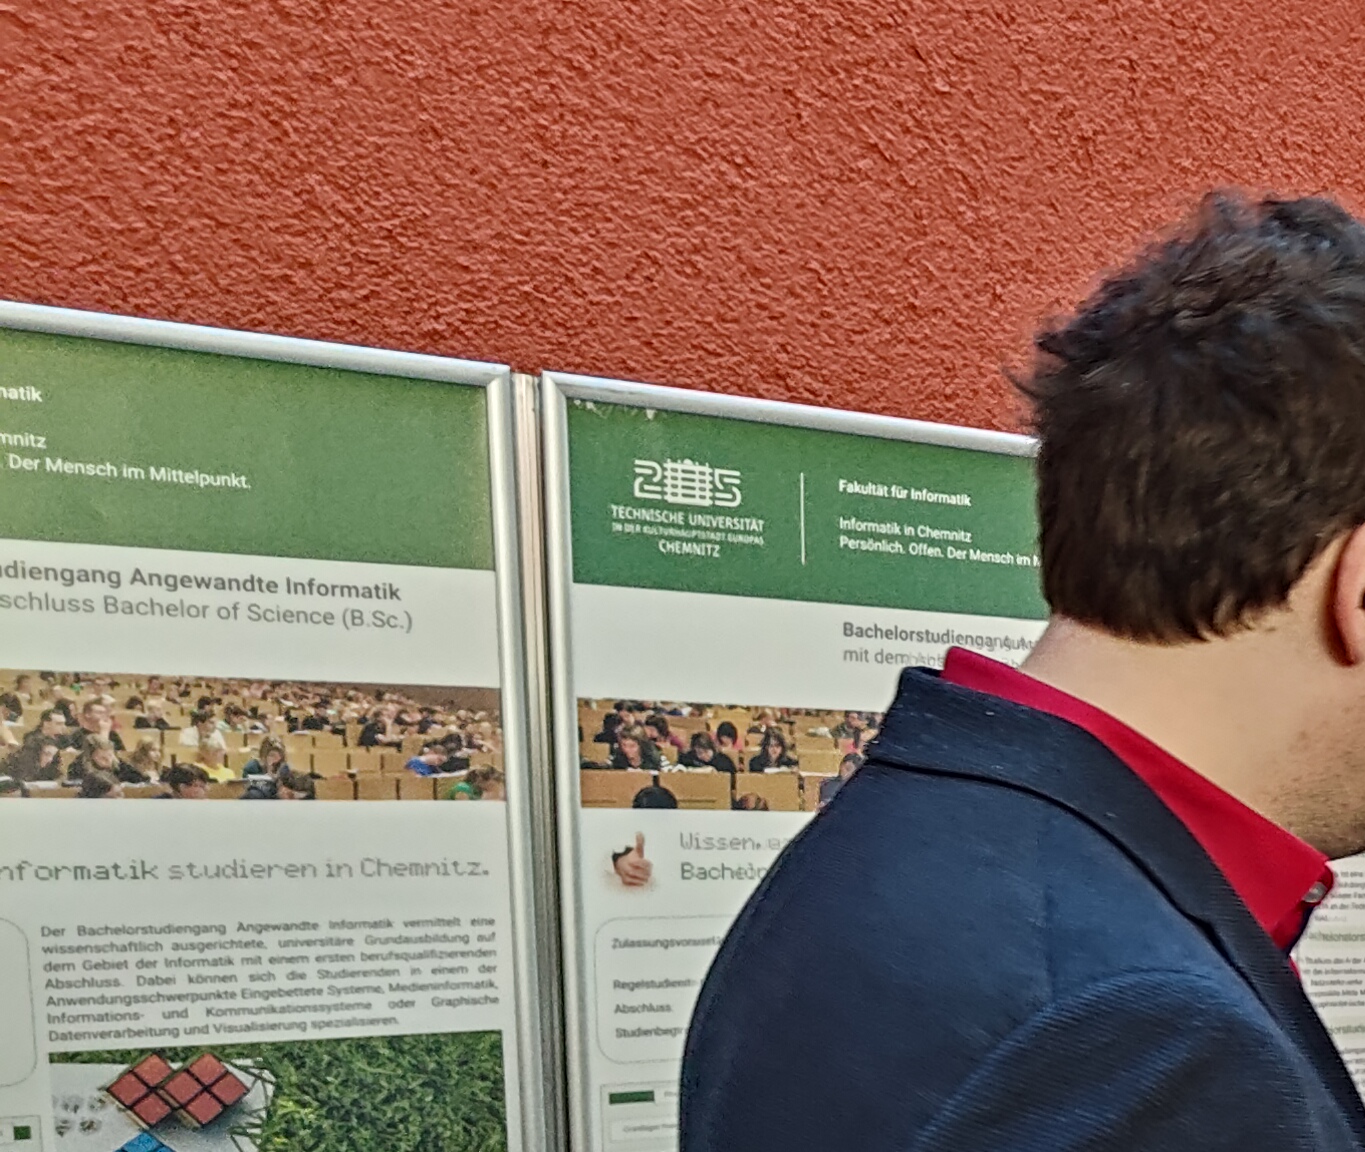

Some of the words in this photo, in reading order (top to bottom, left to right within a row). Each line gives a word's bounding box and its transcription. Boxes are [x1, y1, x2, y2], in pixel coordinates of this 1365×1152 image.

[9, 453, 39, 471] Der
[45, 457, 118, 477] Mensch
[122, 463, 145, 480] im
[150, 466, 252, 489] Mittelpunkt.
[838, 479, 888, 497] Fakultät
[891, 486, 908, 499] für
[911, 488, 972, 507] Informatik
[610, 504, 685, 525] TECHNISCHE
[688, 512, 765, 532] UNIVERSITÄT
[839, 517, 901, 535] Informatik
[904, 523, 915, 536] in
[918, 525, 972, 543] Chemnitz
[658, 539, 721, 558] CHEMNITZ
[908, 543, 944, 558] Offen.
[947, 546, 967, 560] Der
[969, 549, 1014, 565] Mensch
[1016, 553, 1031, 566] im
[0, 560, 121, 588] diengang
[130, 566, 279, 594] Angewandte
[286, 576, 402, 601] Informatik
[103, 595, 210, 620] Bachelor
[216, 602, 240, 621] of
[247, 604, 336, 627] Science
[342, 607, 414, 634] (B.Sc.)
[843, 648, 870, 663] mit
[168, 858, 318, 880] studieren
[326, 858, 354, 879] in
[360, 857, 491, 879] Chemnitz.
[41, 926, 65, 937] Der
[77, 923, 226, 936] Bachelorstudiengang
[237, 920, 319, 935] Angewandte
[329, 918, 393, 930] Informatik
[403, 916, 461, 929] vermittelt
[470, 916, 495, 927] eine
[42, 939, 163, 953] wissenschaftlich
[278, 934, 354, 947] universitäre
[365, 932, 469, 945] Grundausbildung
[43, 960, 75, 971] dem
[82, 957, 129, 970] Gebiet
[135, 957, 158, 968] der
[164, 954, 234, 967] Informatik
[241, 953, 262, 965] mit
[268, 952, 309, 964] einem
[315, 950, 355, 962] ersten
[136, 973, 176, 986] Dabei
[188, 972, 237, 984] können
[249, 970, 275, 982] sich
[317, 966, 400, 979] Studierenden
[46, 988, 236, 1006] Anwendungsschwerpunkte
[241, 985, 323, 1001] Eingebettete
[162, 1006, 189, 1019] und
[205, 1000, 372, 1017] Kommunikationssysteme
[49, 1025, 180, 1041] Datenverarbeitung
[184, 1022, 209, 1034] und
[213, 1019, 307, 1033] Visualisierung
